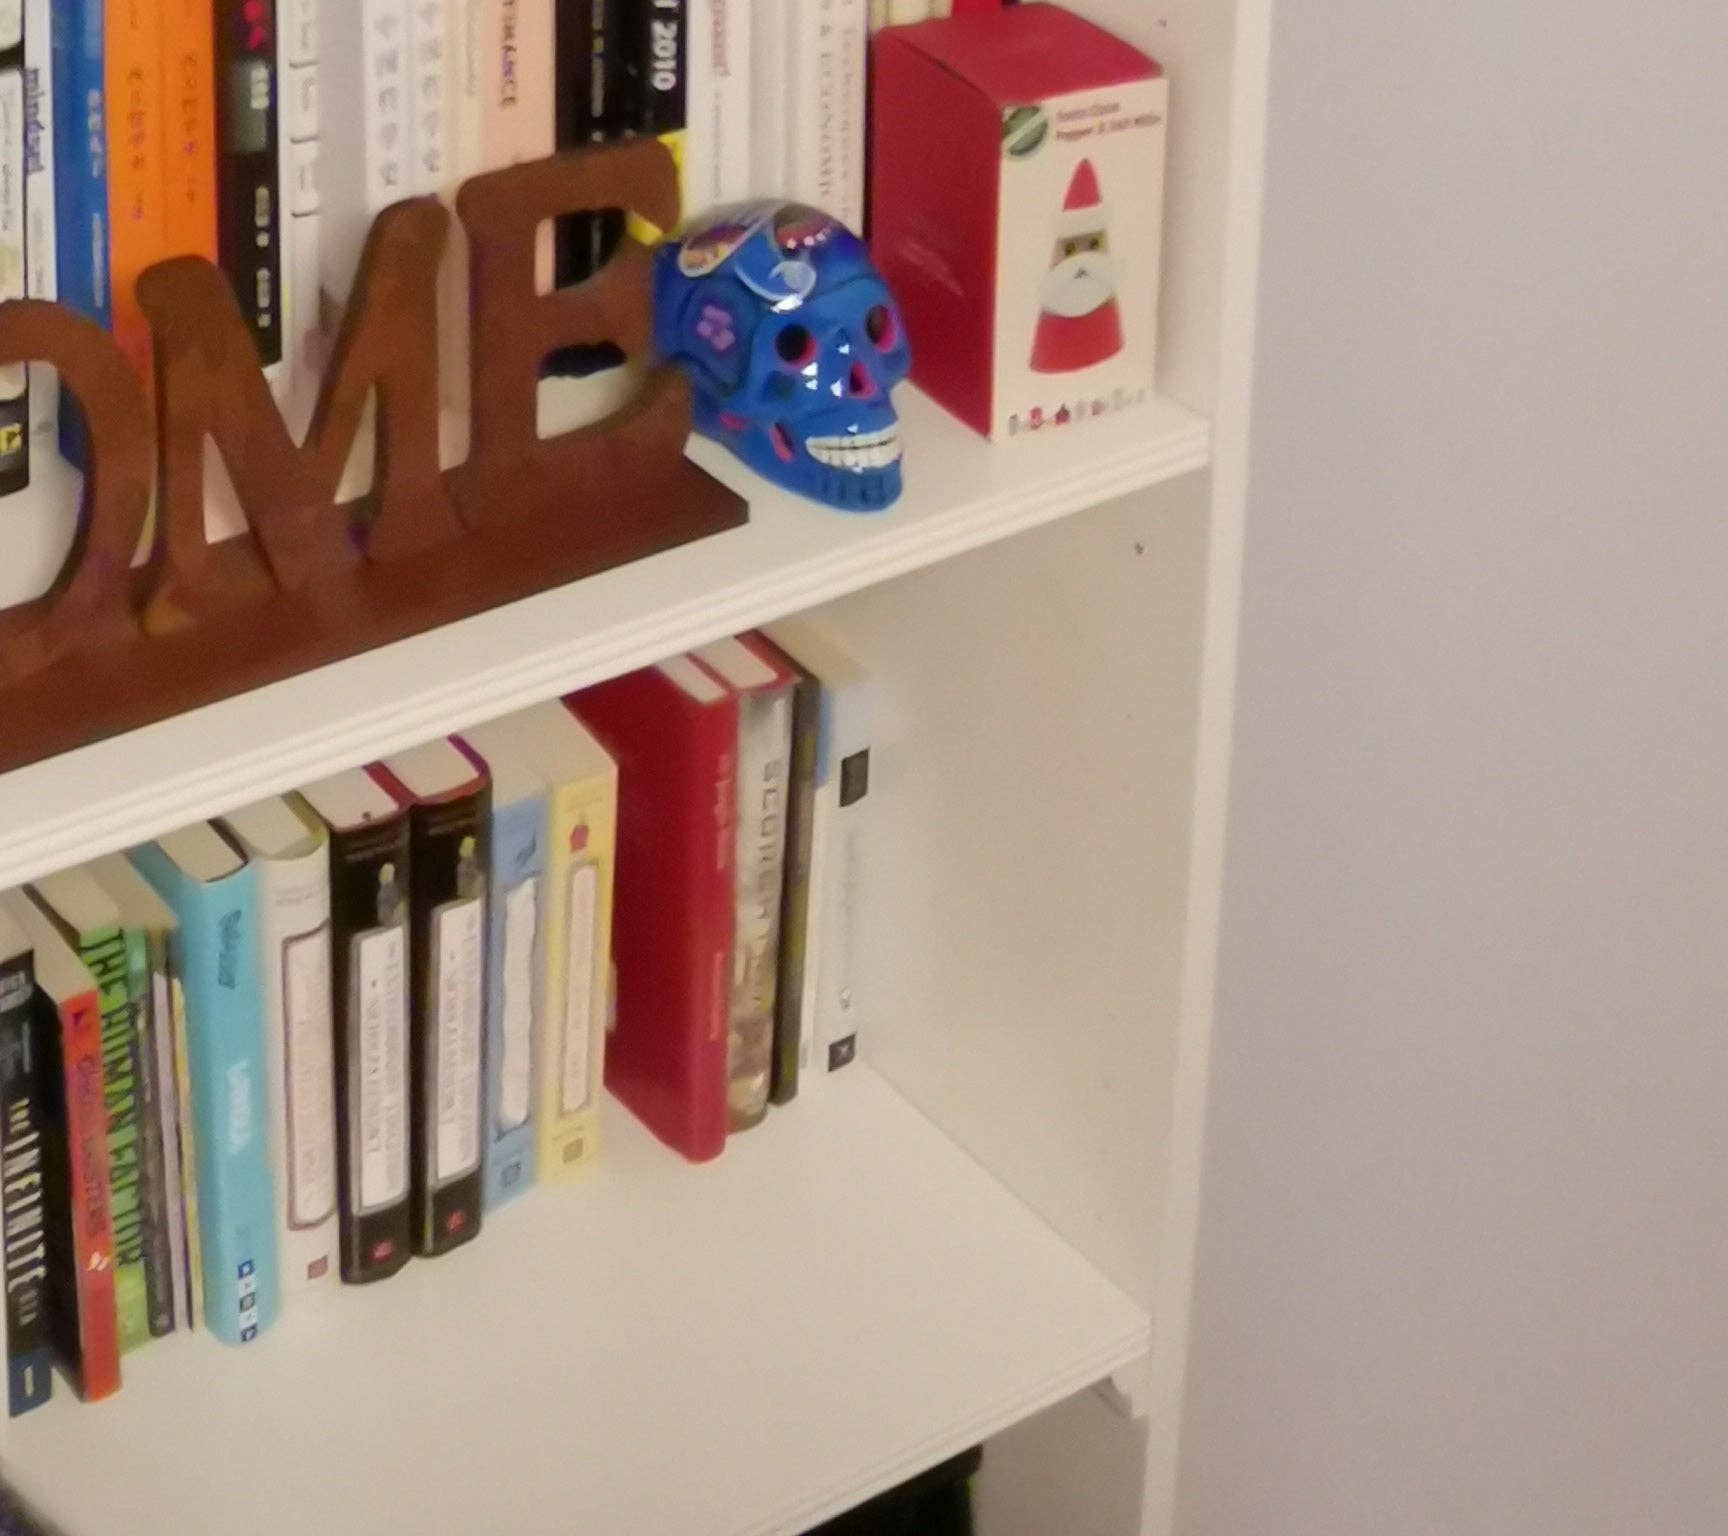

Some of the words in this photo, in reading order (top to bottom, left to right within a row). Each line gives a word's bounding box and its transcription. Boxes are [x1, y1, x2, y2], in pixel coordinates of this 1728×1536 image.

[650, 18, 678, 92] 2010
[24, 67, 46, 175] mindset
[78, 926, 127, 998] THE
[99, 1002, 140, 1134] HUMAN
[8, 1097, 31, 1134] THE
[4, 1132, 45, 1293] INFINITE
